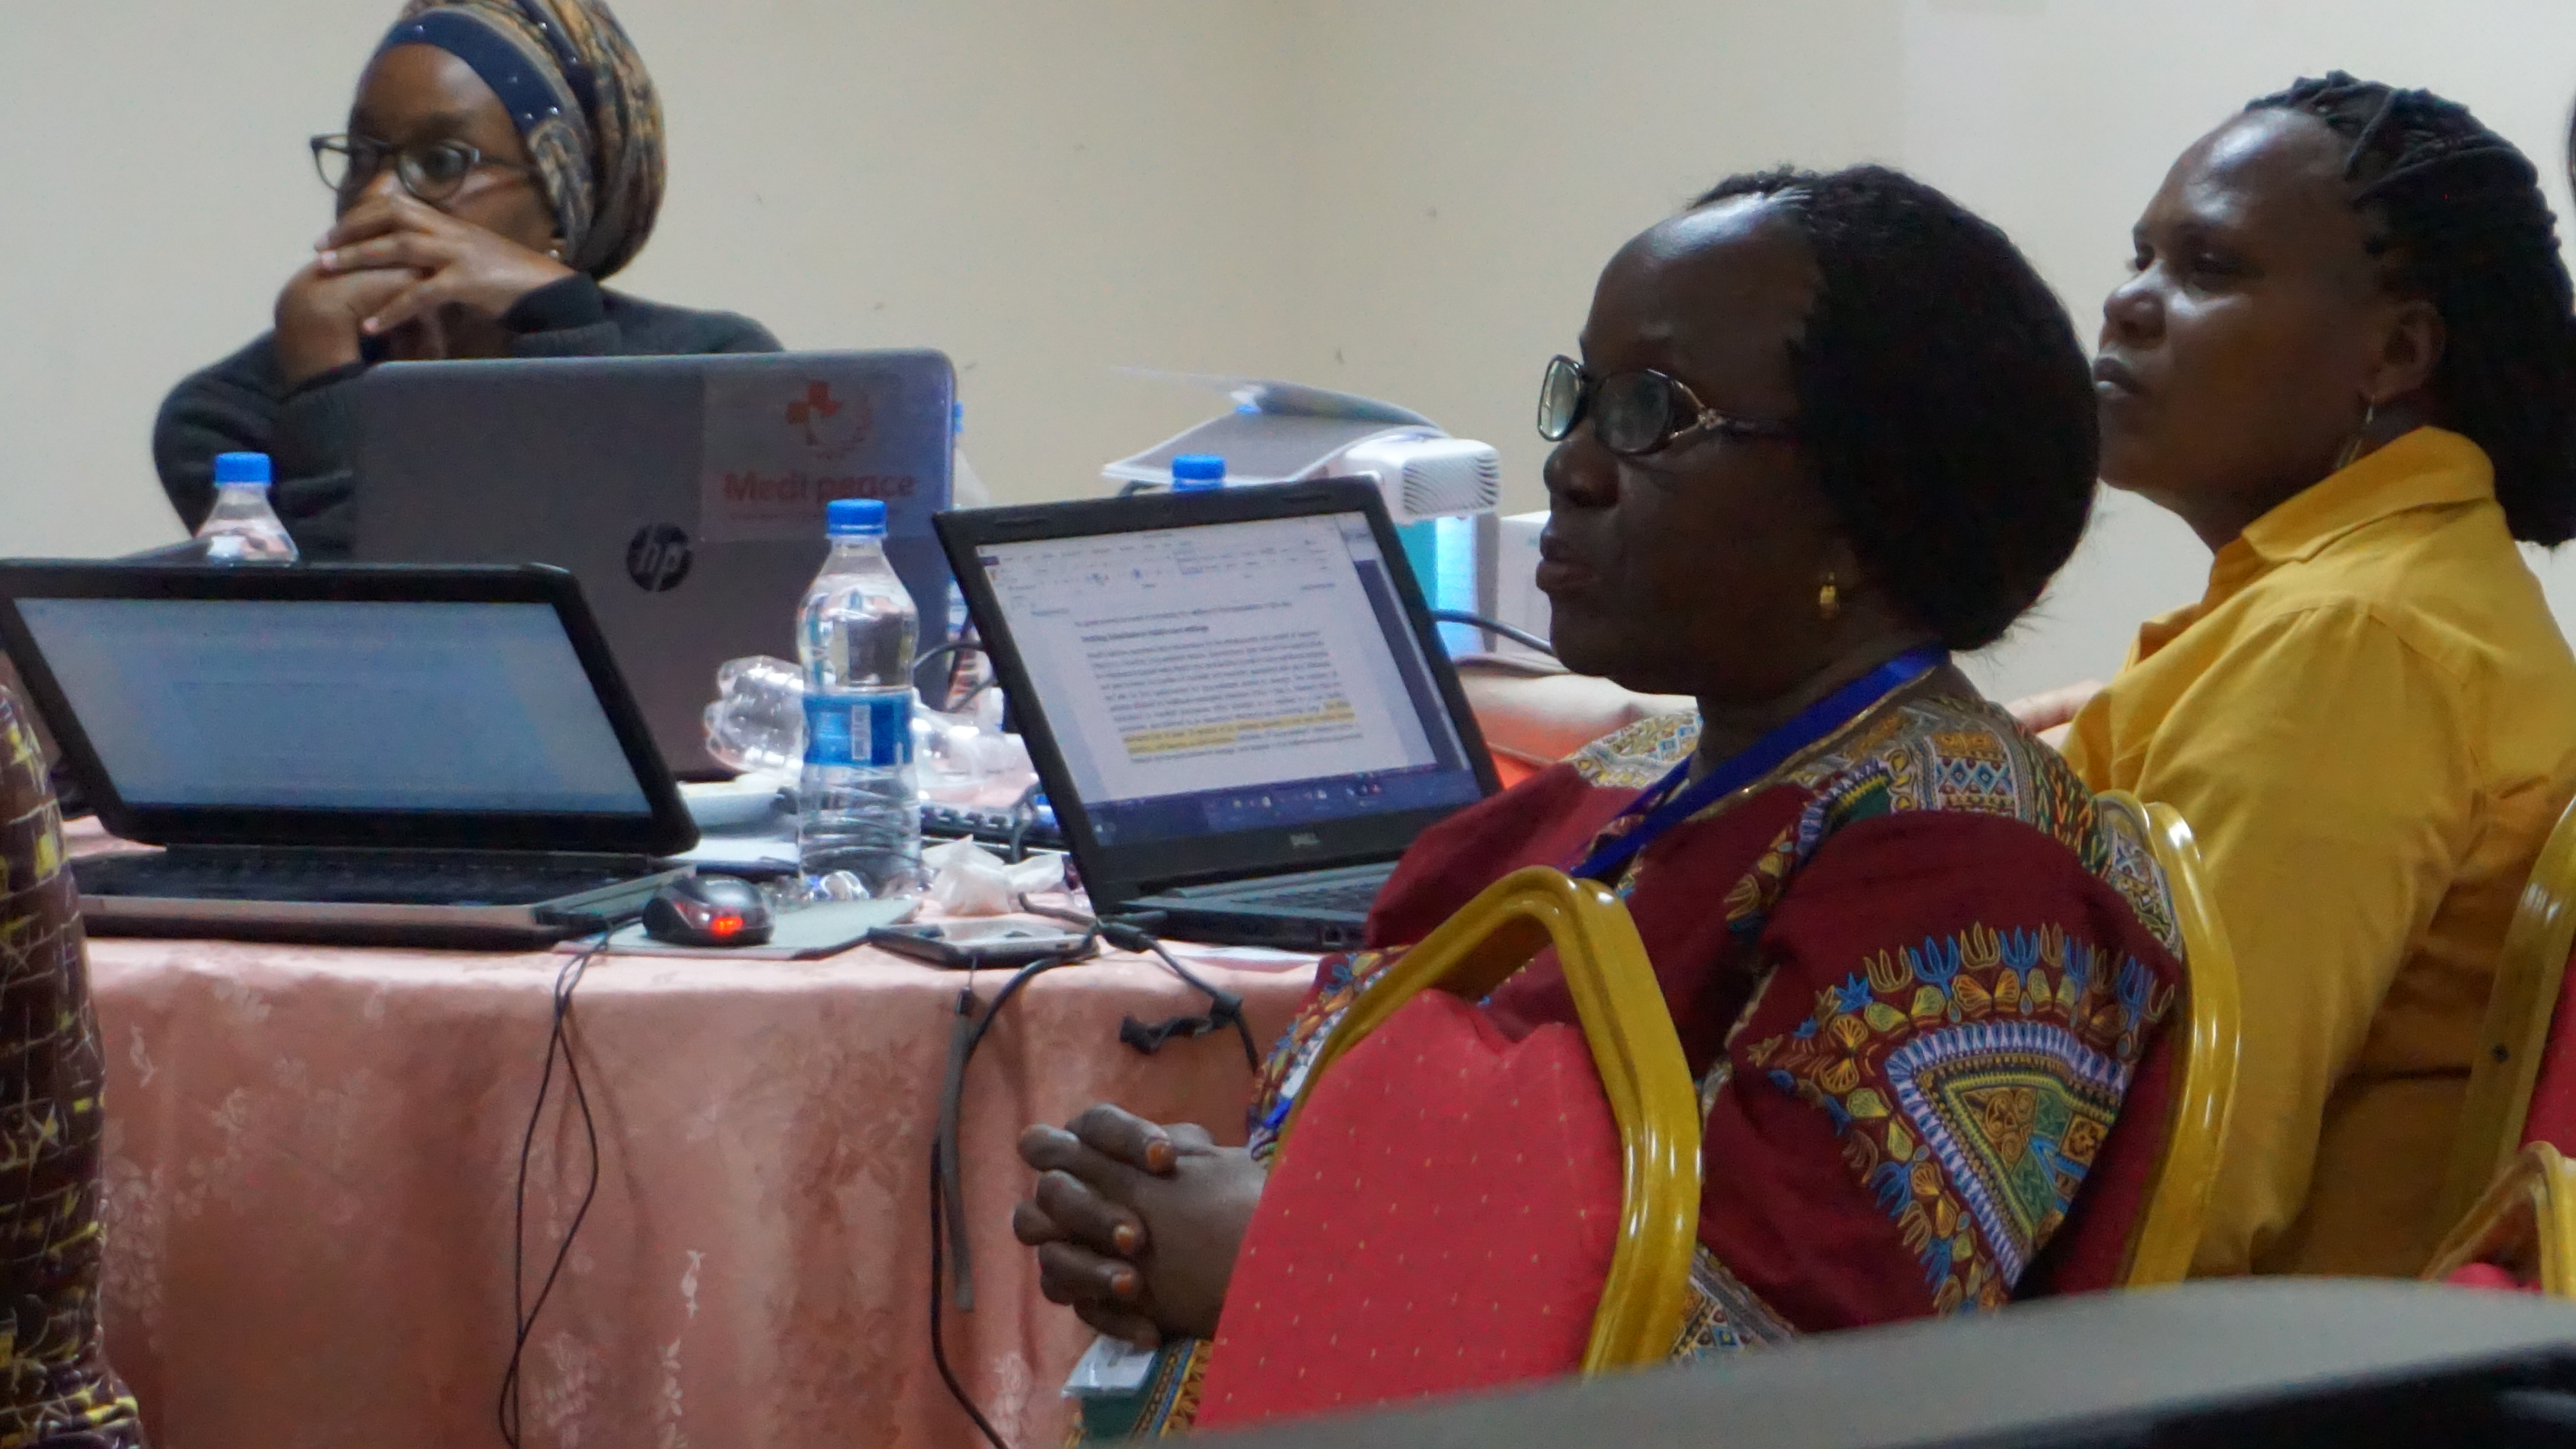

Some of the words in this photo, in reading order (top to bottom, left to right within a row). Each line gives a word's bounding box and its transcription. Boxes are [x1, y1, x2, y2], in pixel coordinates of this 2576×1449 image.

[724, 470, 808, 500] Medi
[817, 475, 915, 503] peace
[631, 524, 687, 592] hp
